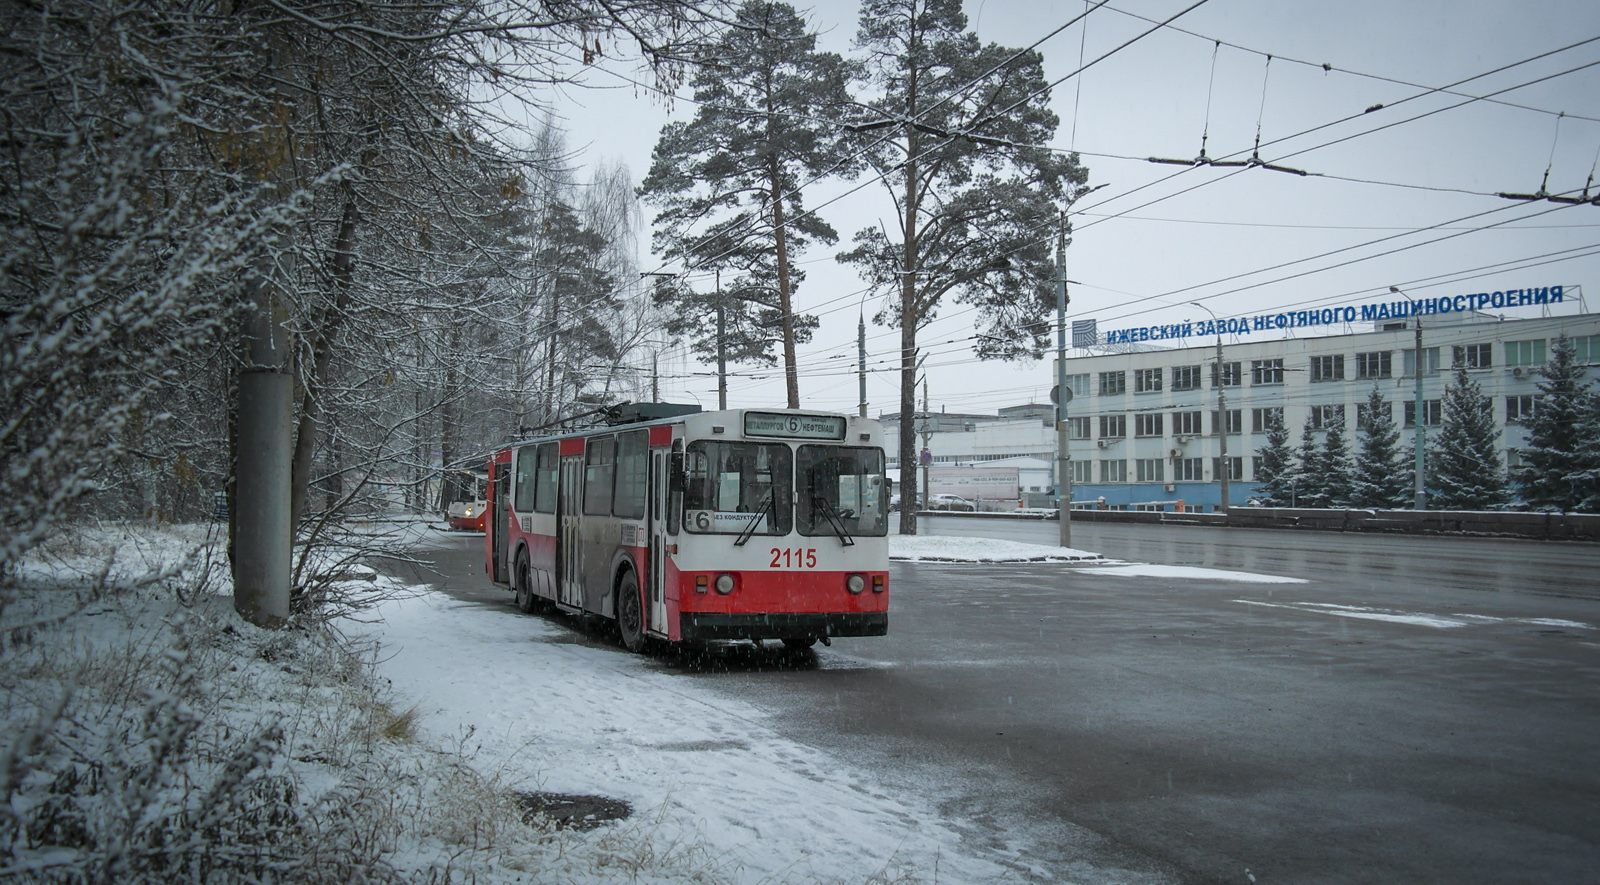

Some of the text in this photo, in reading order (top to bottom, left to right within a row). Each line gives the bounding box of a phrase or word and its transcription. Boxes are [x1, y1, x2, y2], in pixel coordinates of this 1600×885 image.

[1106, 285, 1563, 345] ИЖЕВСКИЙ ЗАВОД НЕФТЯНОГО МАШИНОСТРОЕНИЯ
[789, 416, 798, 432] 6
[802, 423, 835, 433] НЕФТЕМАШ
[695, 511, 710, 530] 6
[769, 547, 817, 568] 2115
